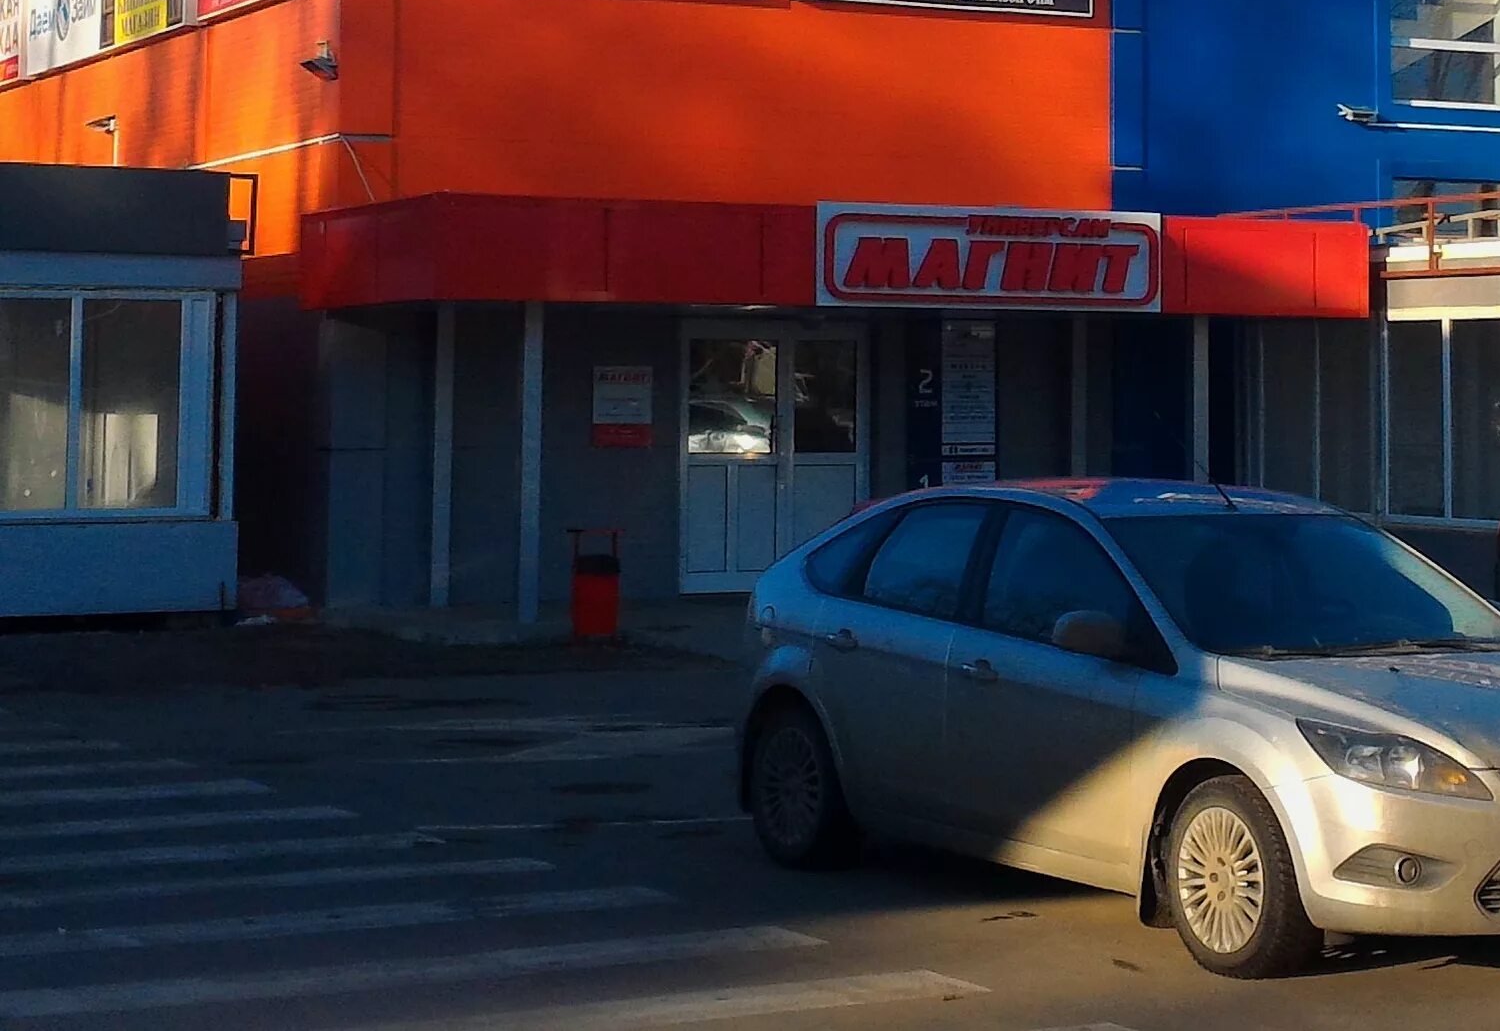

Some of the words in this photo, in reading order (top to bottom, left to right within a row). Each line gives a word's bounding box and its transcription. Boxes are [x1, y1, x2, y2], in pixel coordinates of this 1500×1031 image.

[967, 215, 1112, 237] УНИВЕРСАМ
[843, 237, 1139, 293] МАГНИТ
[919, 369, 933, 393] 2
